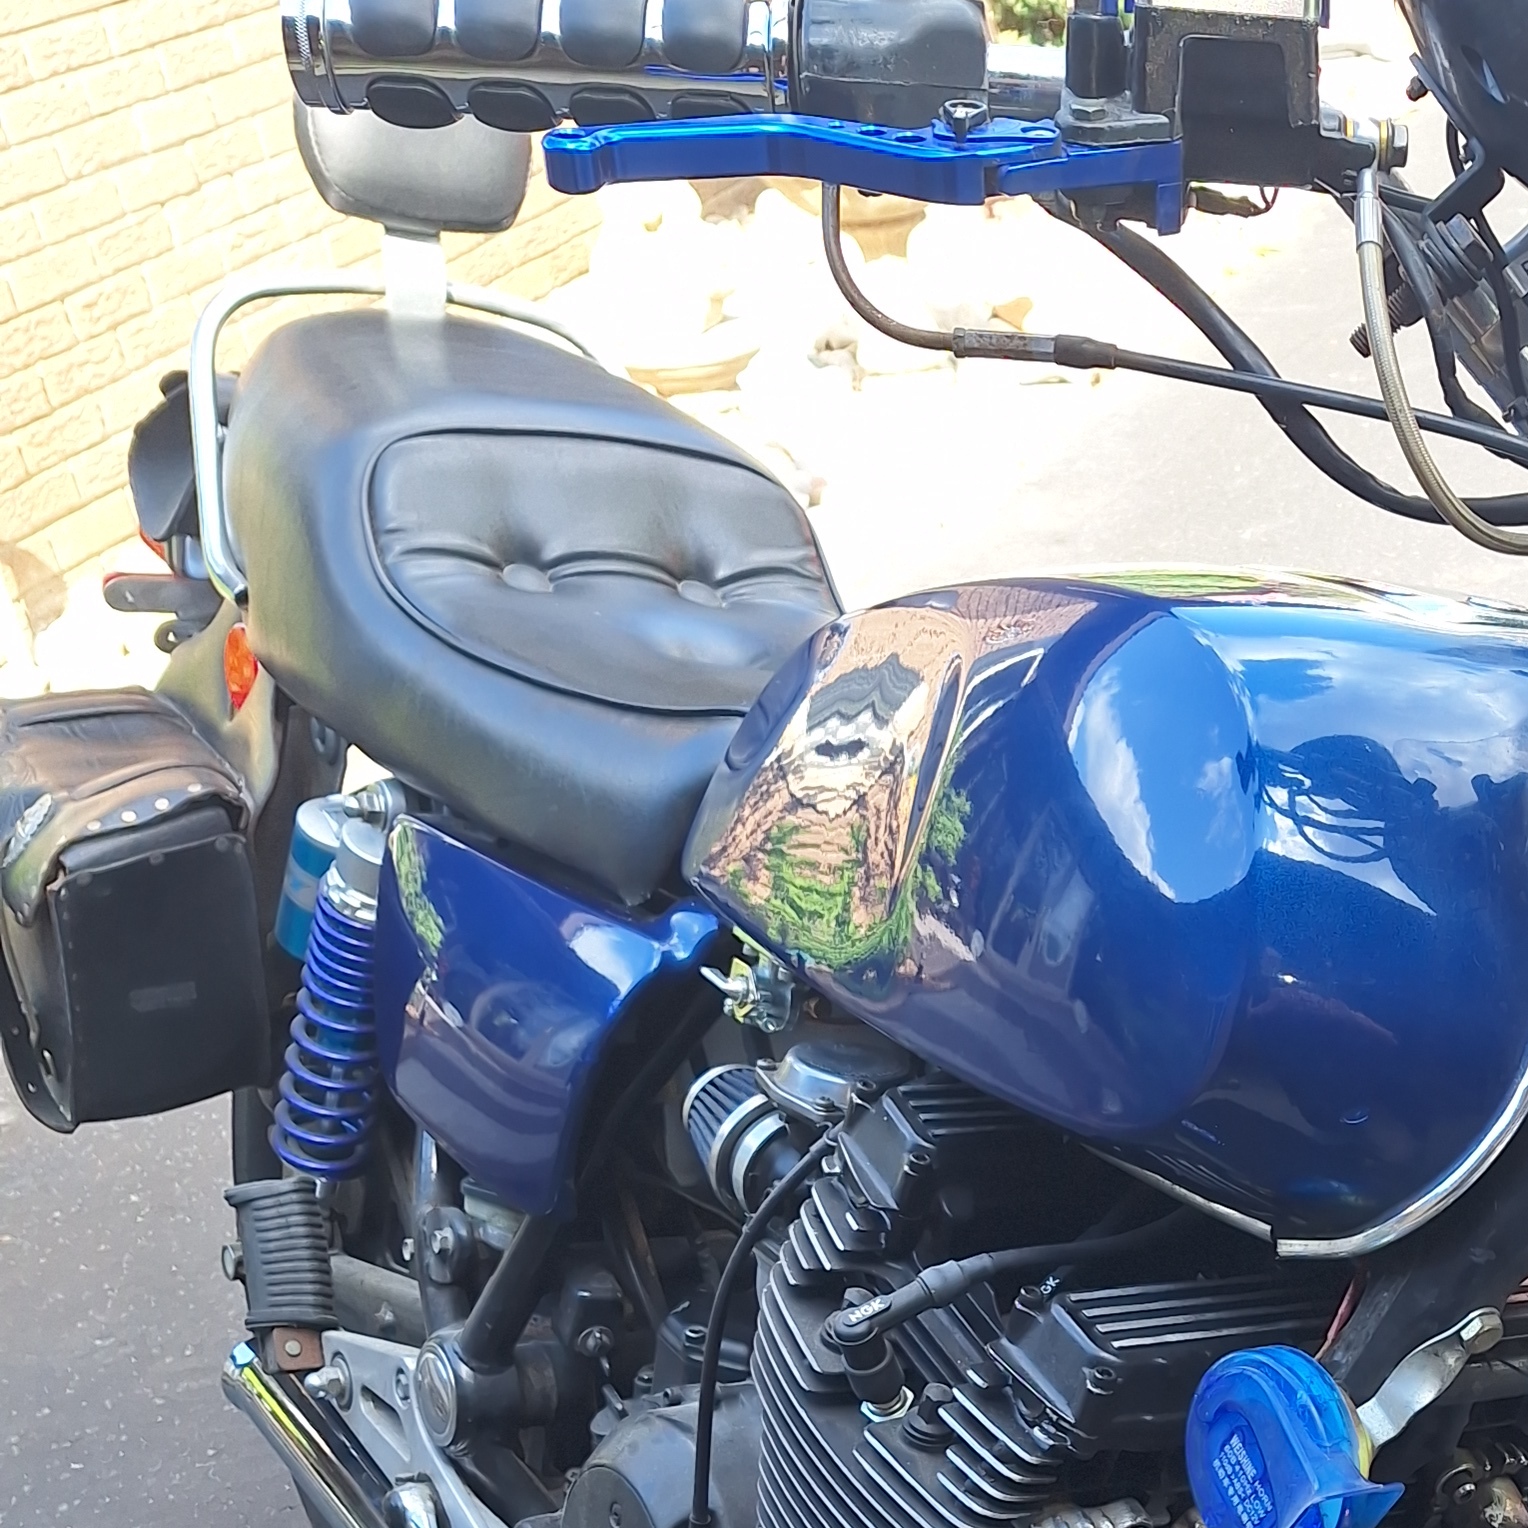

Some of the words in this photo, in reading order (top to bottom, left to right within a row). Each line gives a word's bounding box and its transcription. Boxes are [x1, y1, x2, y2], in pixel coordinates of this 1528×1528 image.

[1040, 1276, 1060, 1295] GK
[848, 1298, 886, 1323] NGK
[1250, 1494, 1267, 1518] LOW
[1254, 1480, 1273, 1511] HORN
[1244, 1498, 1260, 1525] DC12V
